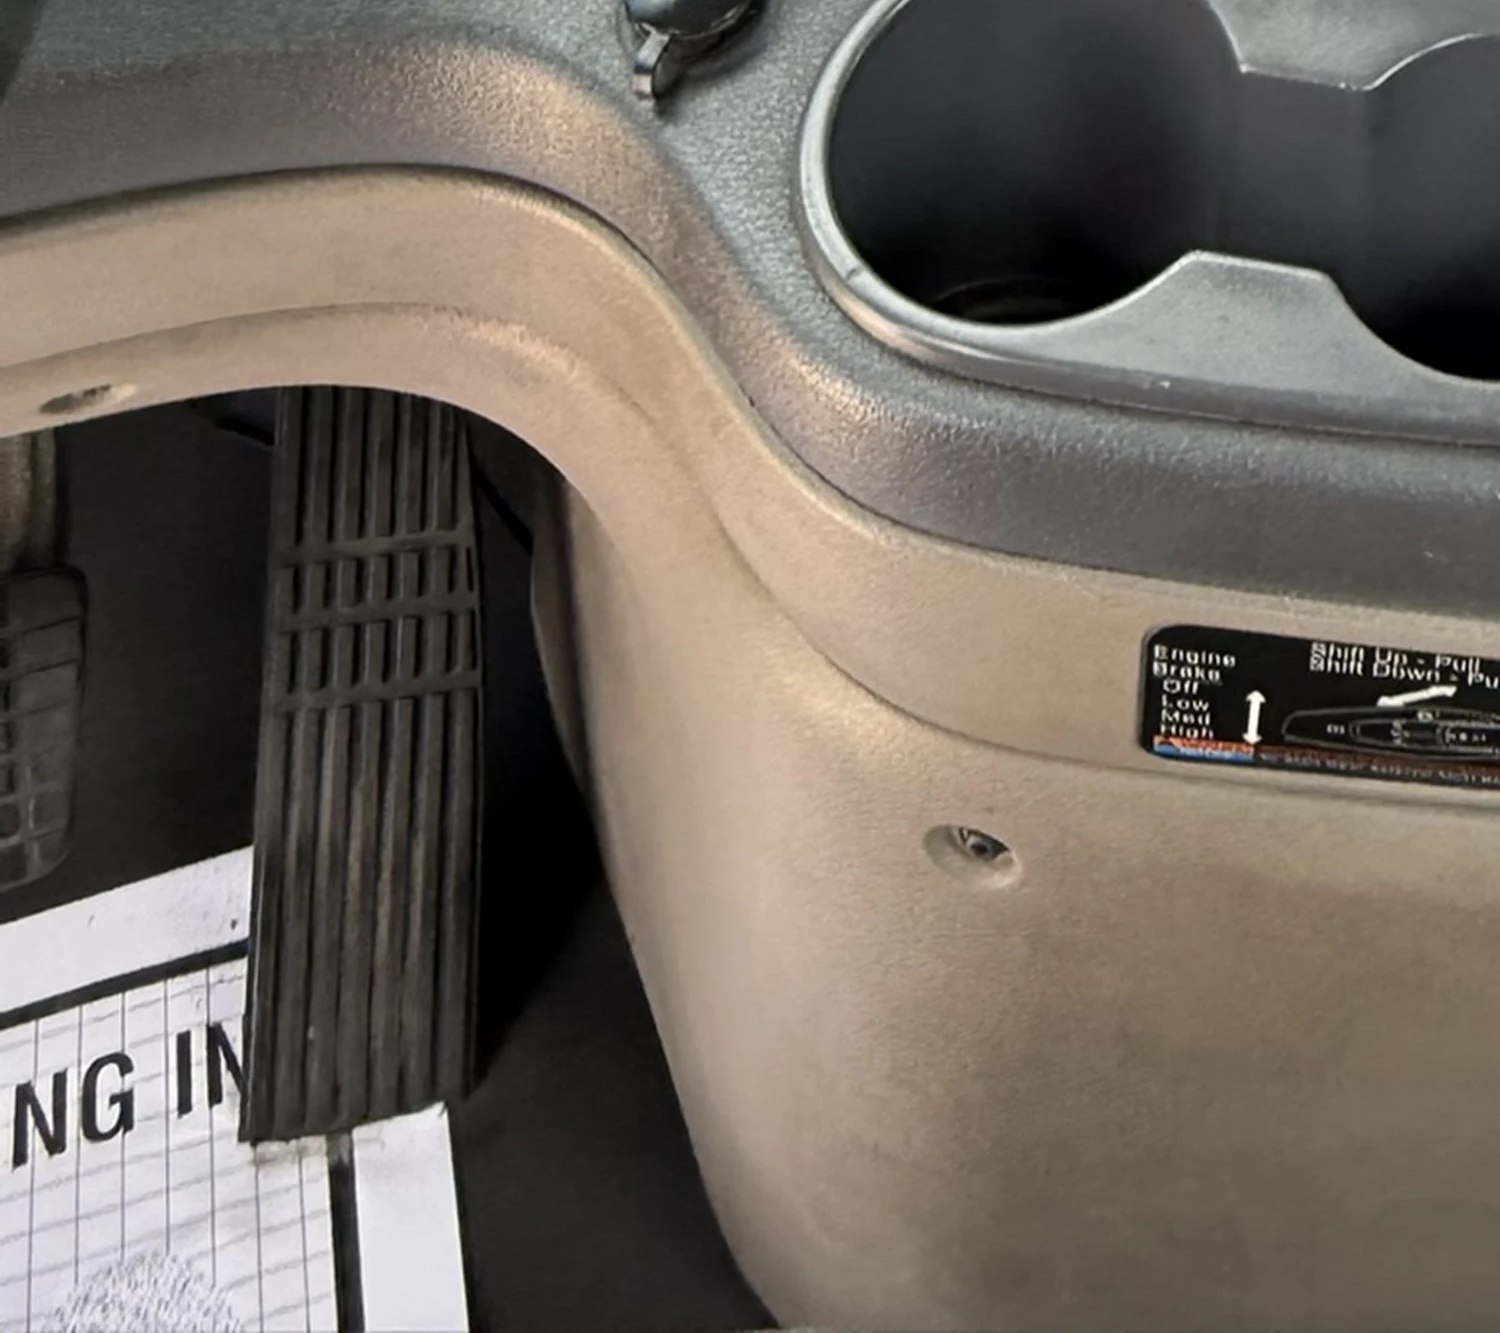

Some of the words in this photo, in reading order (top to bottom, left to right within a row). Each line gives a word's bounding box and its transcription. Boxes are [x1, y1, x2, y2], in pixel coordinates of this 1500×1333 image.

[1153, 644, 1236, 667] Engine
[1310, 641, 1365, 663] Shift
[1435, 653, 1481, 673] Pull
[1152, 661, 1221, 683] Brake
[1309, 655, 1364, 676] Shift
[1372, 660, 1441, 682] Down
[1163, 679, 1199, 695] Off
[1161, 694, 1210, 712] Low
[1161, 709, 1211, 726] Med
